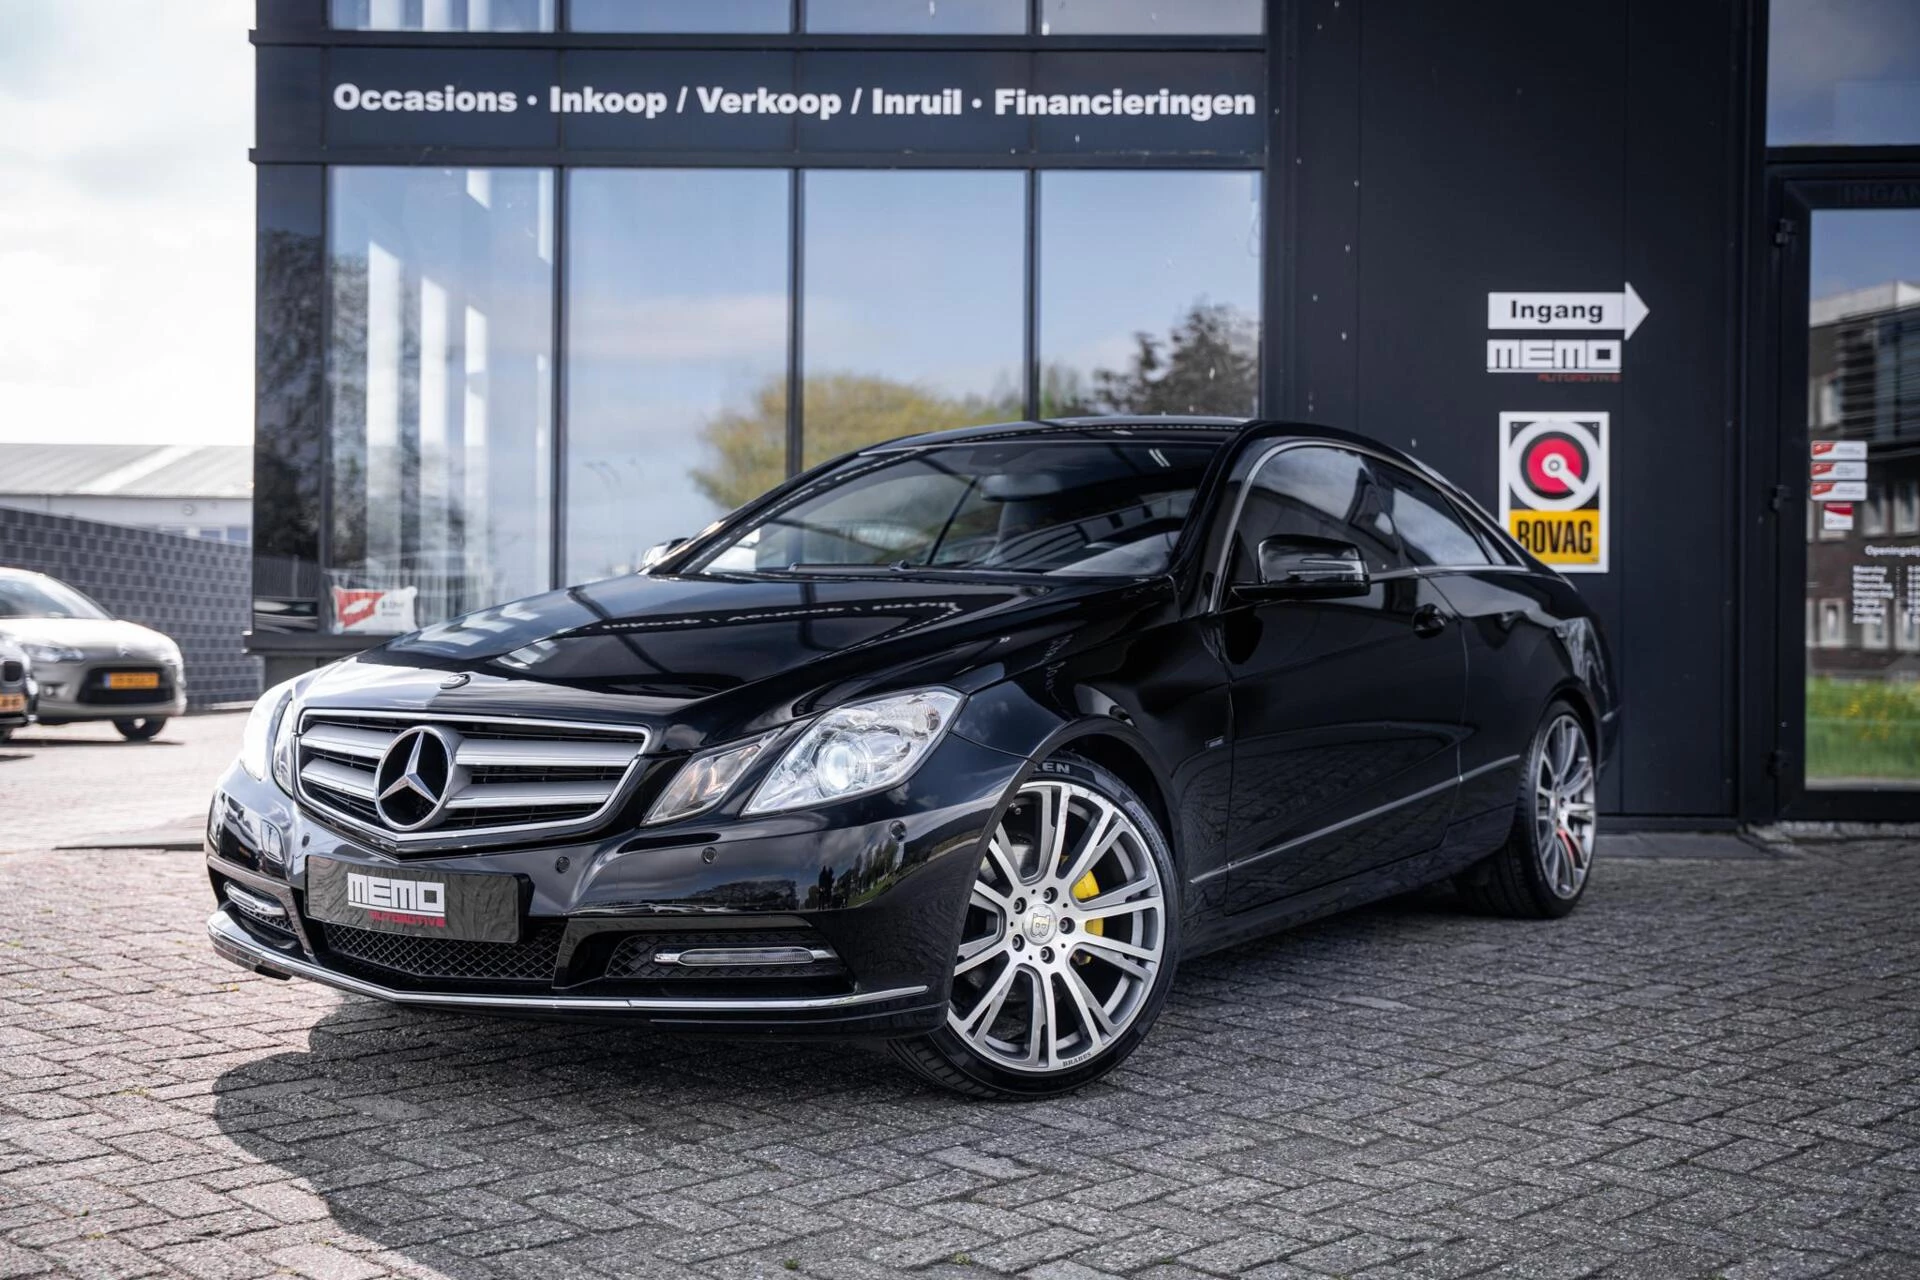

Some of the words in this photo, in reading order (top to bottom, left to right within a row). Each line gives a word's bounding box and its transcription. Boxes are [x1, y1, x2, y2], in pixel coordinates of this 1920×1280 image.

[333, 83, 518, 112] Occasions
[549, 86, 668, 119] Inkoop
[696, 86, 842, 120] Verkoop
[872, 88, 963, 115] Inruil
[994, 88, 1257, 122] Financieringen
[1511, 300, 1604, 324] Ingang
[1487, 339, 1622, 371] MEMO
[1516, 520, 1593, 554] BOVAG
[347, 872, 445, 911] MEMO
